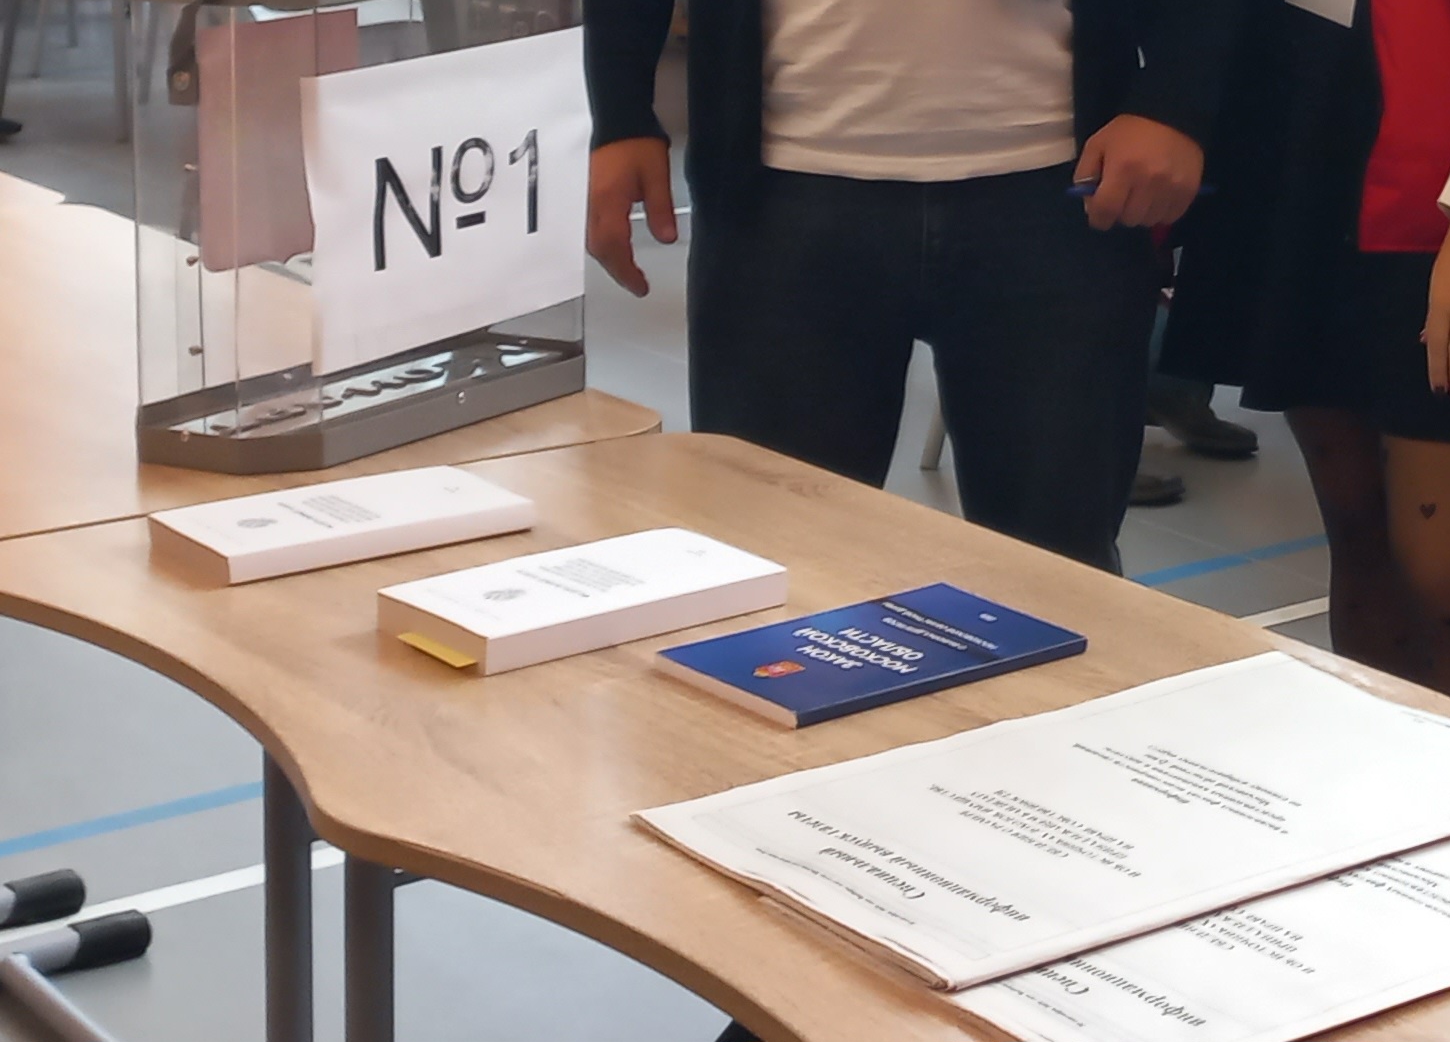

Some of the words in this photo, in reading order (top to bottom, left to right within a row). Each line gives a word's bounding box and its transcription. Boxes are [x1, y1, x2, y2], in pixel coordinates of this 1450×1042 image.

[793, 628, 917, 673] МОСКОВСКОЙ
[796, 645, 863, 668] ЗАКОН
[838, 628, 923, 660] ОБЛАСТИ
[835, 833, 894, 857] выпуск
[818, 847, 925, 899] Специальный
[888, 856, 1030, 921] информационный
